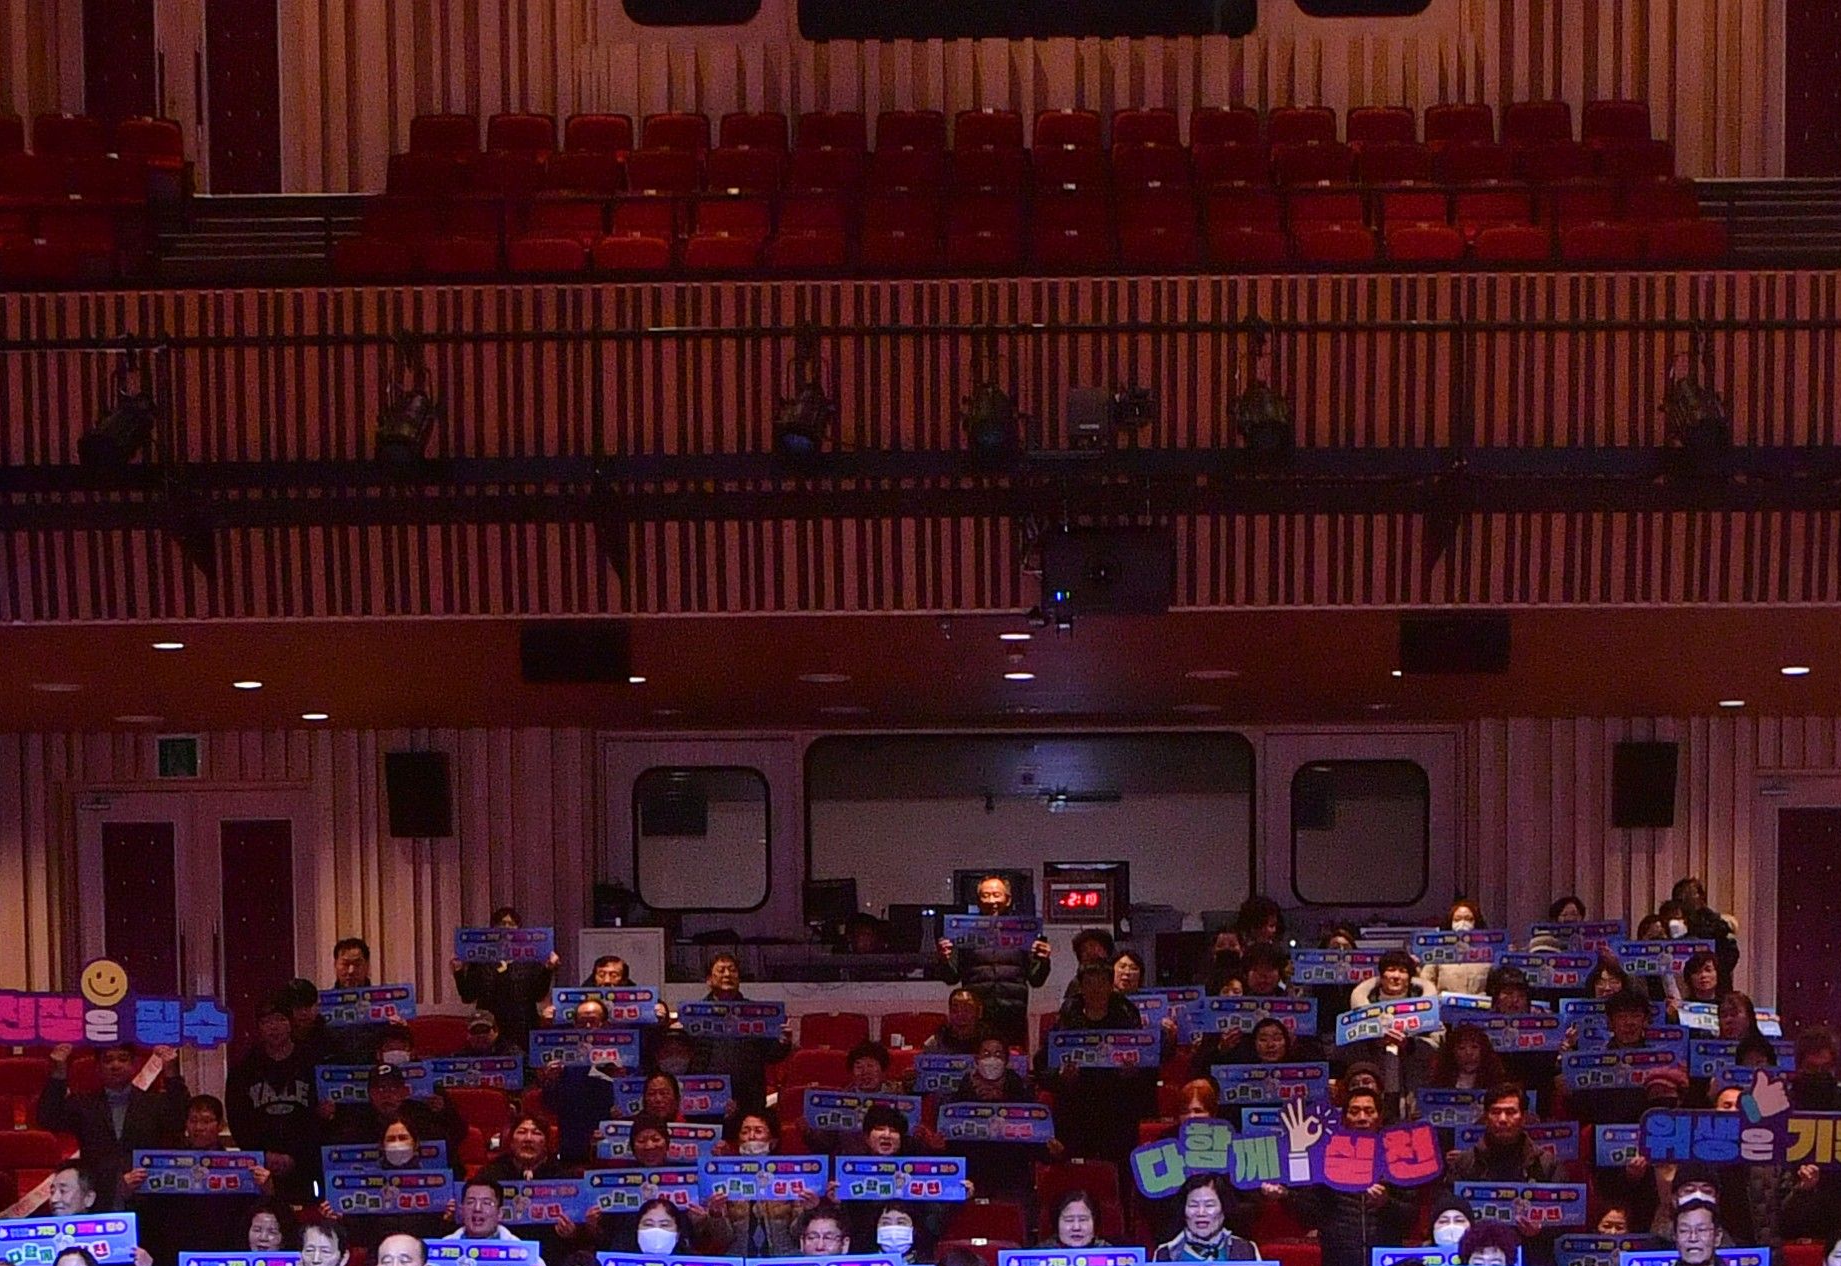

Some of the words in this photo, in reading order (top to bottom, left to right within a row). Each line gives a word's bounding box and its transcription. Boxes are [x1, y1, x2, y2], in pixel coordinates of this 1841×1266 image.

[135, 999, 229, 1045] 필수
[1135, 1123, 1282, 1194] 다함께
[1323, 1125, 1440, 1186] 실천
[1645, 1114, 1775, 1161] 위생은
